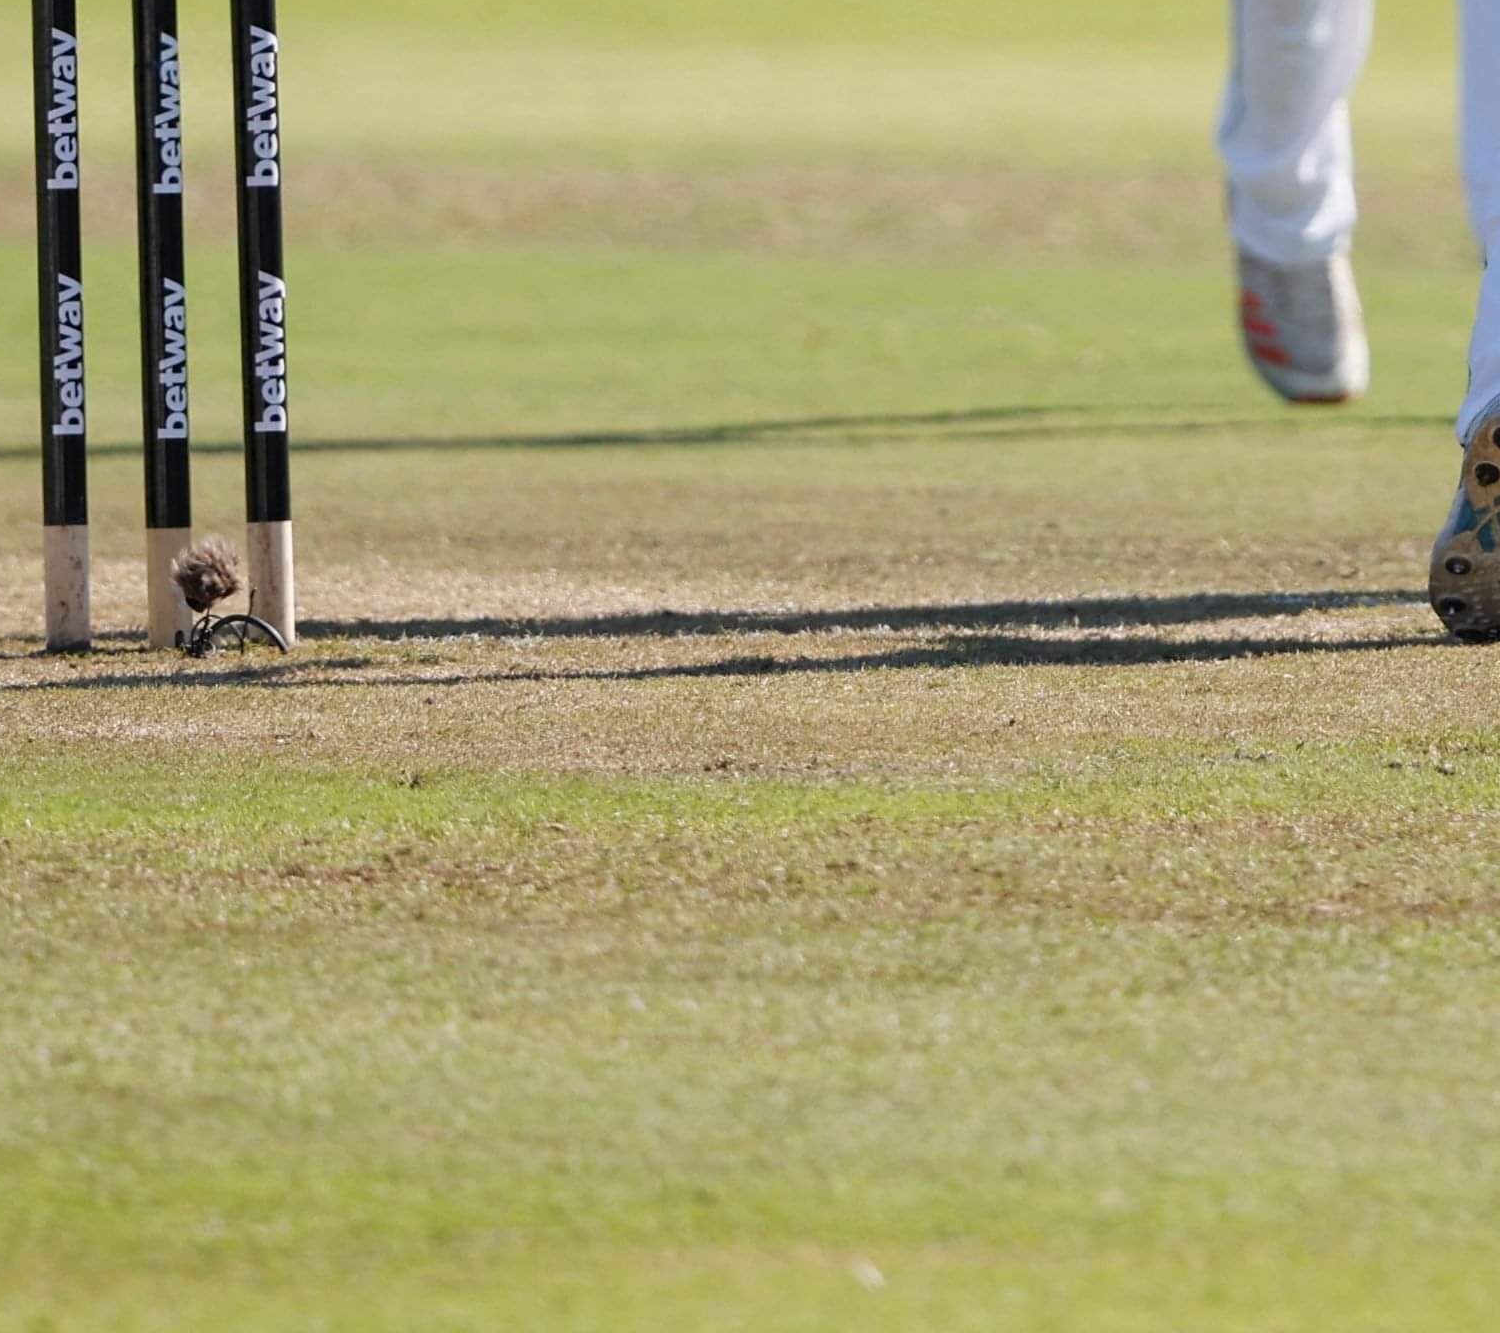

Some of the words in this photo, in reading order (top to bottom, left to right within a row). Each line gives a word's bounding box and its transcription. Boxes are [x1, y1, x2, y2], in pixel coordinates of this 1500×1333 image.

[47, 27, 78, 190] betway
[153, 32, 183, 195] betway
[246, 25, 278, 188] betway
[53, 273, 84, 436] betway
[157, 277, 189, 439] betway
[255, 270, 287, 433] betway
